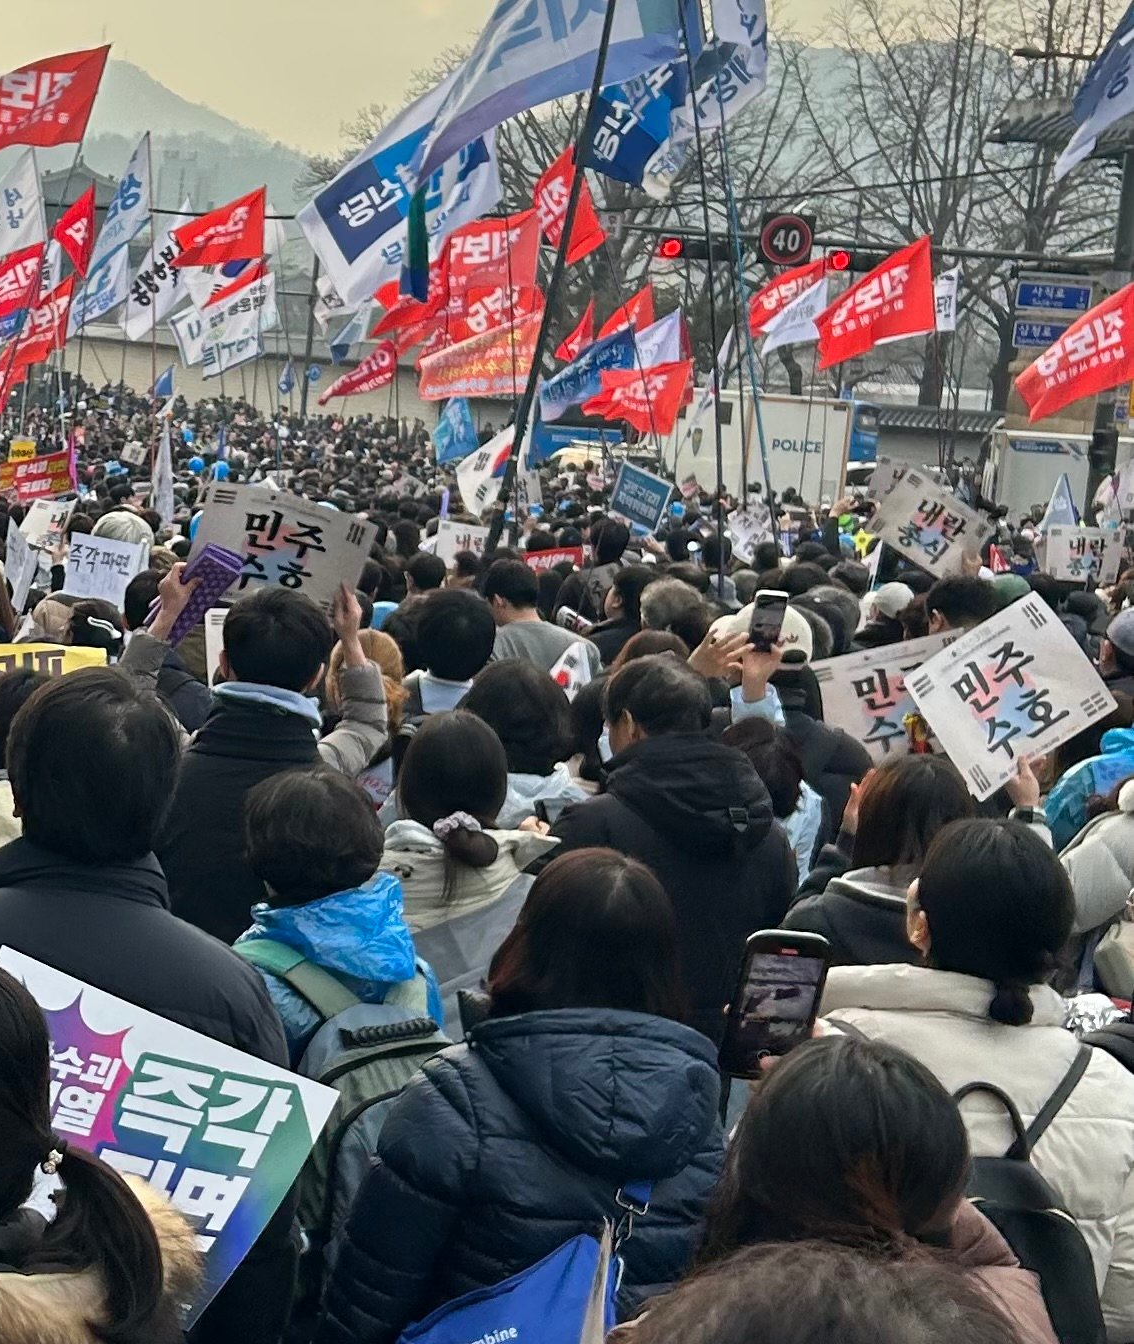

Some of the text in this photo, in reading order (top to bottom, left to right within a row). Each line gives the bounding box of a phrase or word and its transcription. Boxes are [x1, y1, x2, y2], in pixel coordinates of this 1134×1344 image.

[773, 228, 801, 253] 40
[1031, 287, 1066, 299] 사직로
[772, 438, 824, 455] POLICE
[243, 508, 327, 560] 민주
[917, 499, 967, 543] 내란
[69, 543, 131, 577] 즉각 파면
[1069, 536, 1108, 560] 내란
[236, 550, 313, 591] 수호
[950, 640, 1036, 714] 민주
[986, 688, 1071, 760] 수호
[50, 1041, 122, 1092] 수괴
[117, 1058, 294, 1170] 즉각
[98, 1148, 252, 1254] 파면
